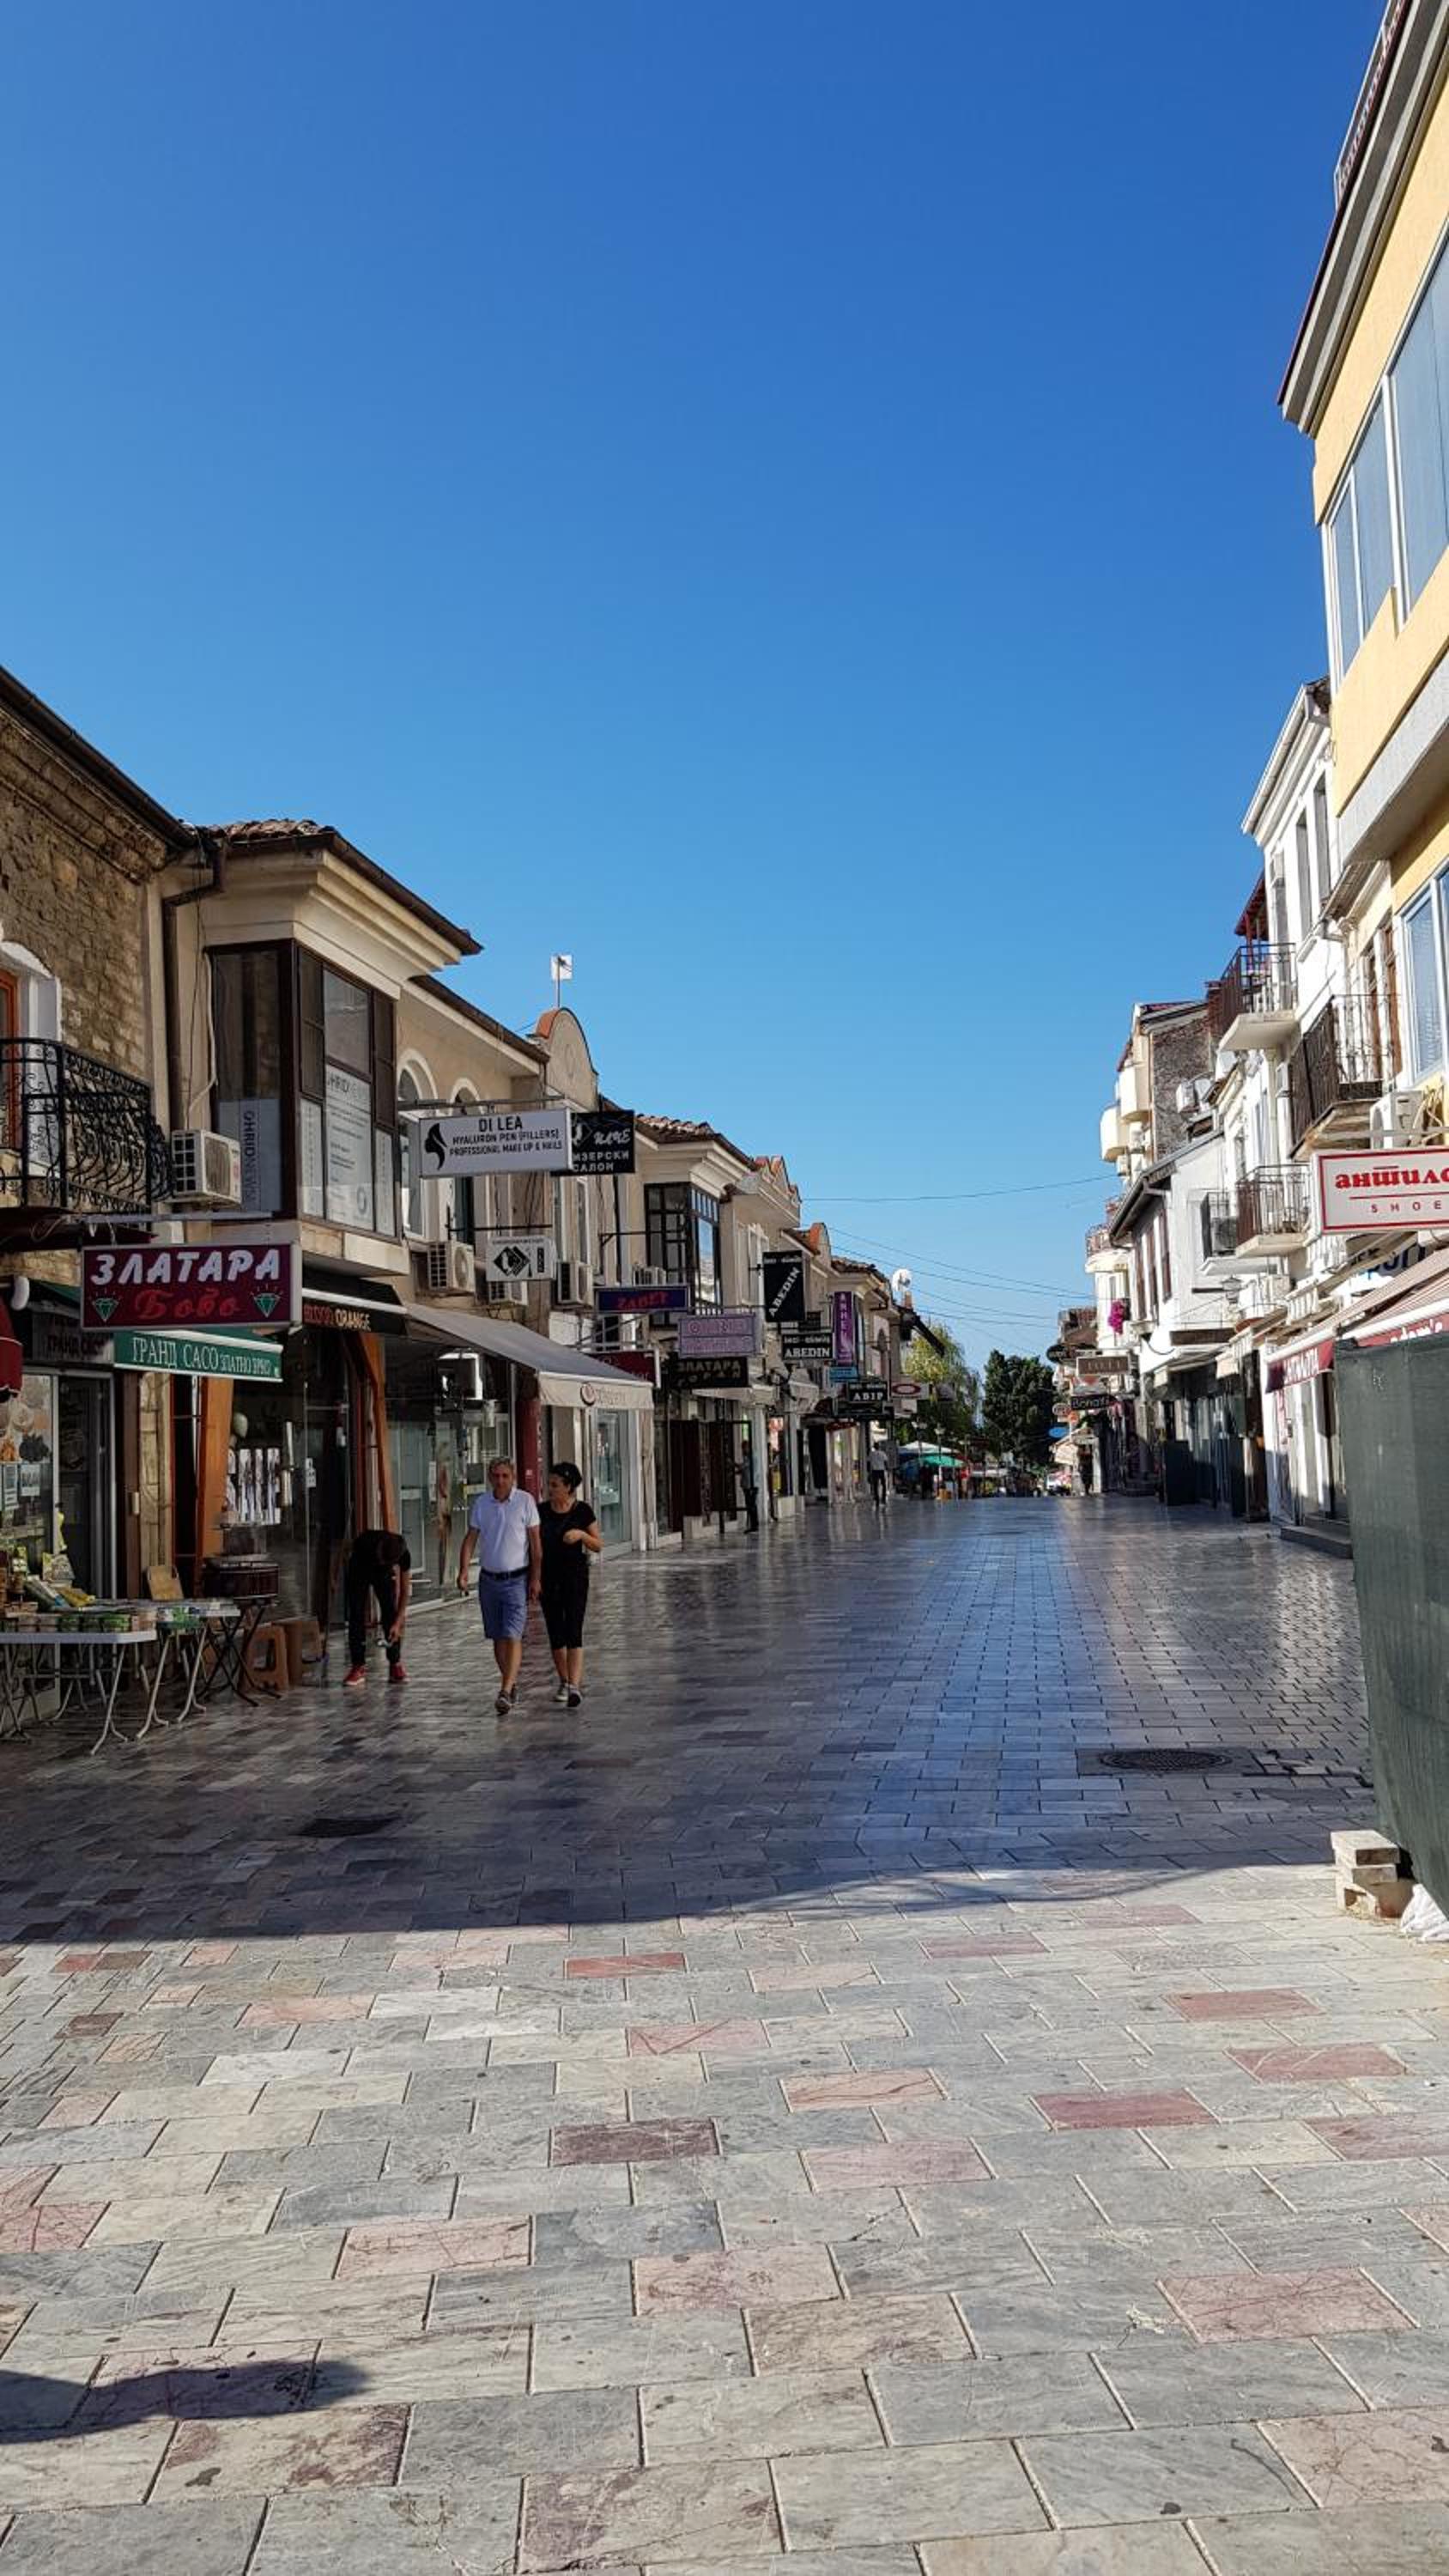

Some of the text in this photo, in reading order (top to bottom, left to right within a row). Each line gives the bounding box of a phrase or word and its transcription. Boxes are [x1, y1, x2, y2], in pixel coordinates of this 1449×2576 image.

[478, 1115, 524, 1133] DI LEA
[452, 1133, 498, 1145] HYALURON
[499, 1131, 516, 1142] PEN
[449, 1144, 500, 1156] PROFESSIONAL
[502, 1143, 523, 1153] MAKE
[523, 1142, 534, 1152] UP
[542, 1140, 563, 1151] NAILS
[90, 1249, 281, 1286] ЗЛАТАРА
[132, 1337, 178, 1369] ГРАНД
[183, 1344, 219, 1370] САСО
